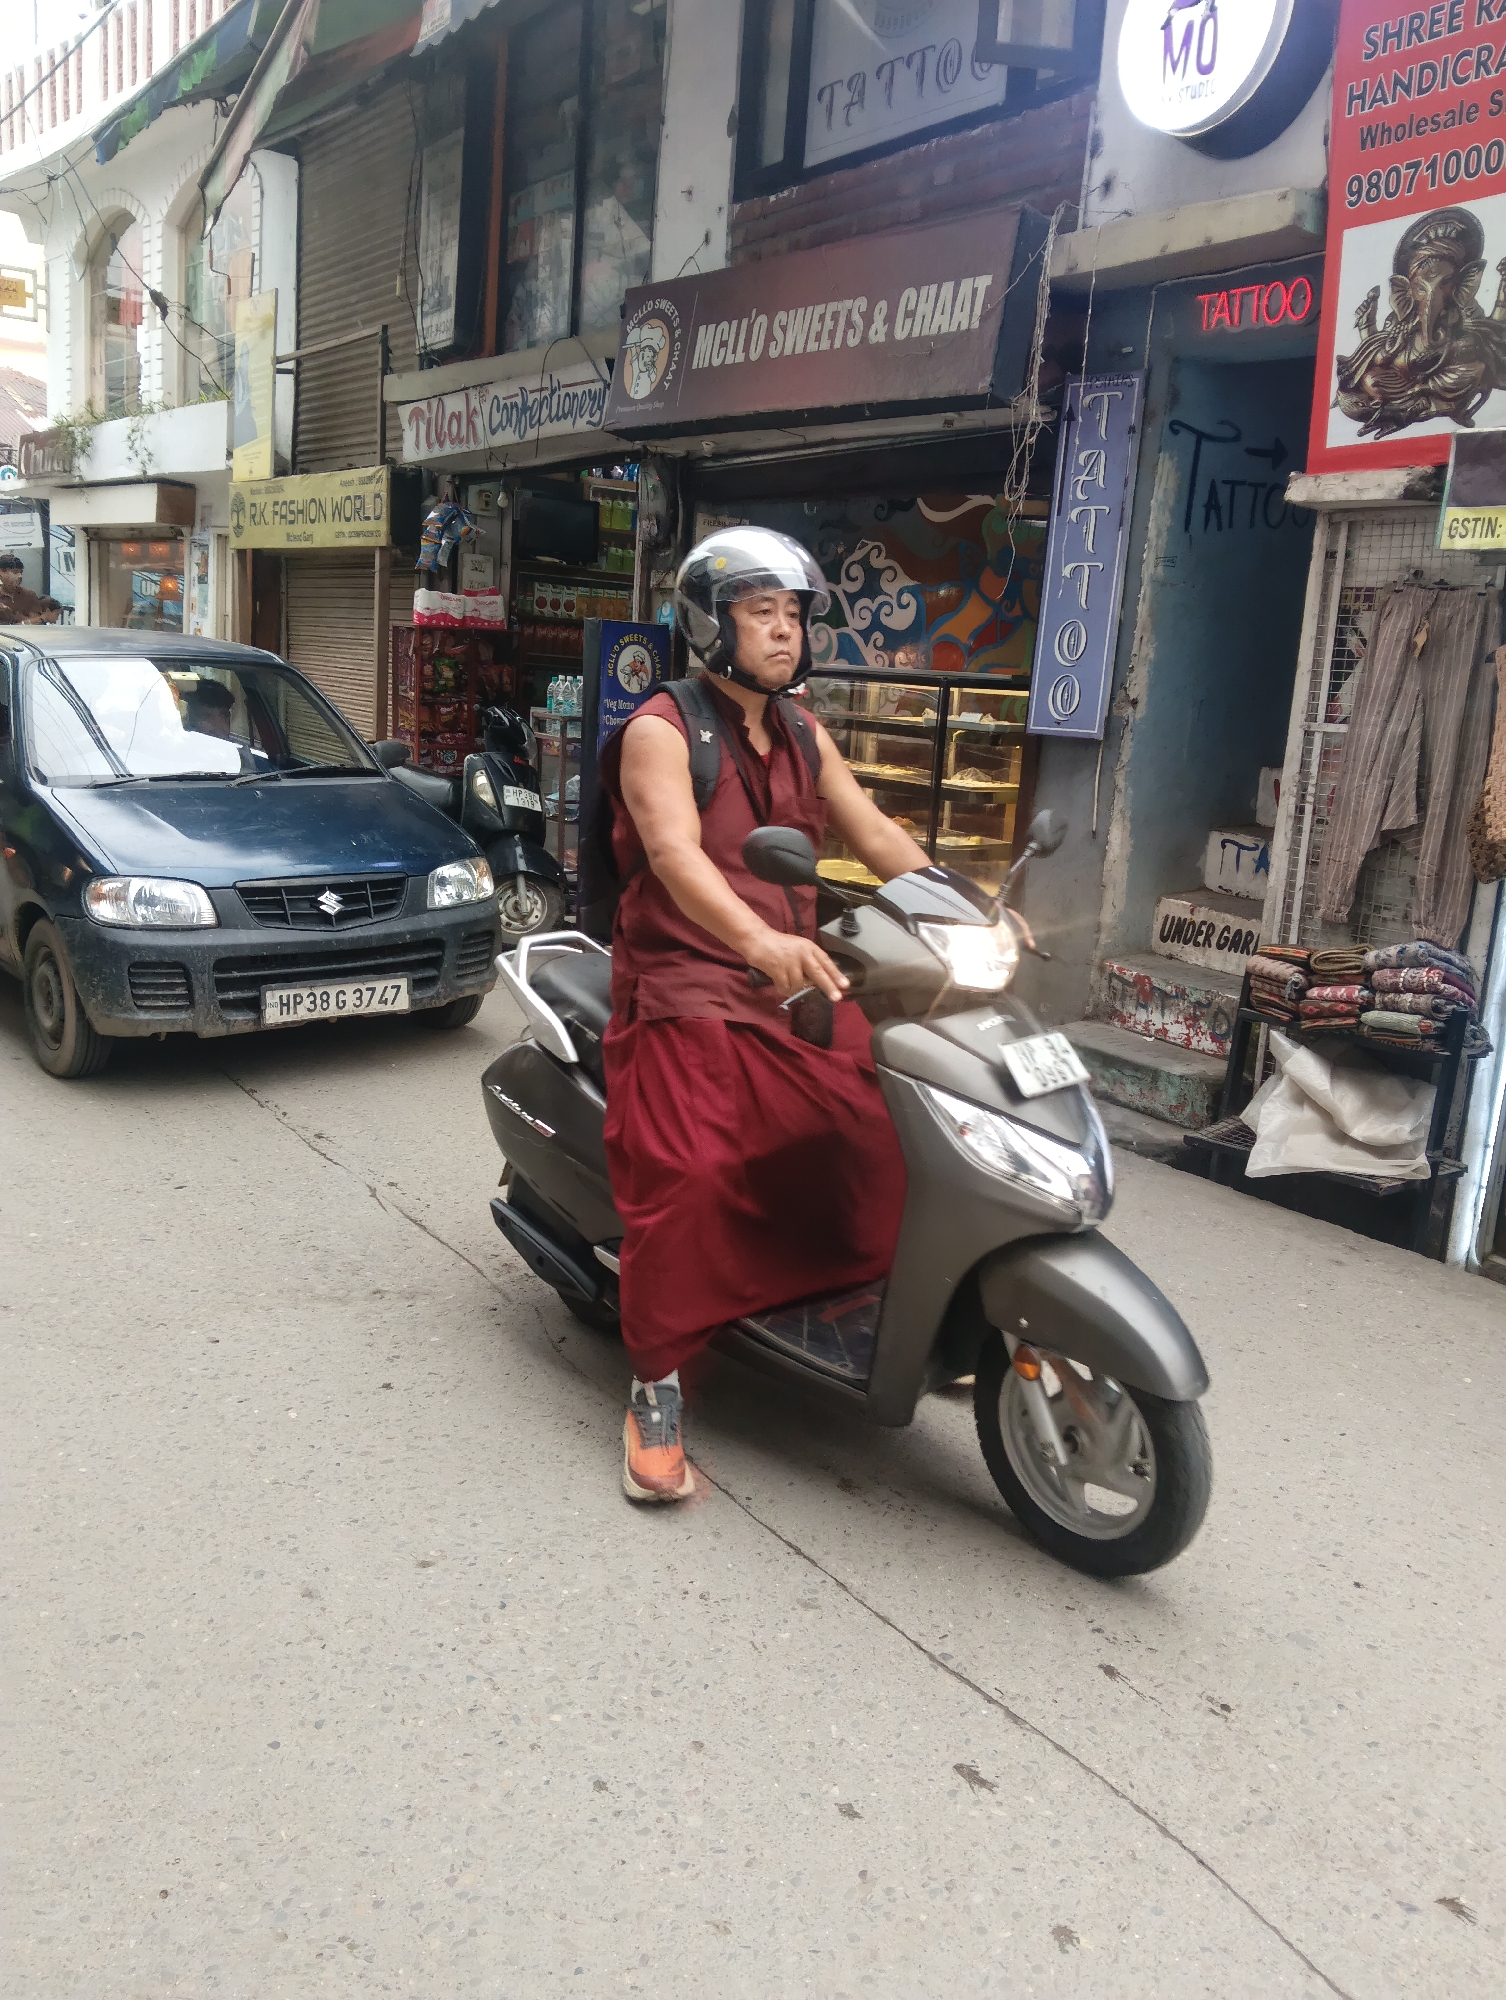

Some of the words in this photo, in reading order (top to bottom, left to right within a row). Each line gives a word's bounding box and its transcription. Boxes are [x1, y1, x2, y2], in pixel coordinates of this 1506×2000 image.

[1363, 0, 1464, 61] SHREE
[1360, 100, 1480, 152] Wholesale
[654, 298, 680, 327] SWEETS
[692, 308, 768, 370] MCLL'O
[768, 296, 868, 359] SWEETS
[869, 300, 889, 345] &
[894, 274, 994, 341] CHAAT
[1196, 276, 1313, 331] TATTOO
[663, 341, 681, 391] CHAAT
[408, 391, 481, 454] Tilak
[488, 374, 609, 441] Confectionery
[250, 501, 270, 526] R.K.
[272, 497, 327, 526] FASHION
[331, 493, 383, 523] WORLD
[1448, 516, 1503, 539] GSTIN:
[1047, 390, 1124, 724] TATTOO
[619, 633, 648, 647] SWEETS
[652, 649, 662, 681] CHAAT
[1159, 913, 1216, 949] UNDER
[335, 989, 347, 1011] G
[352, 984, 402, 1009] 3747
